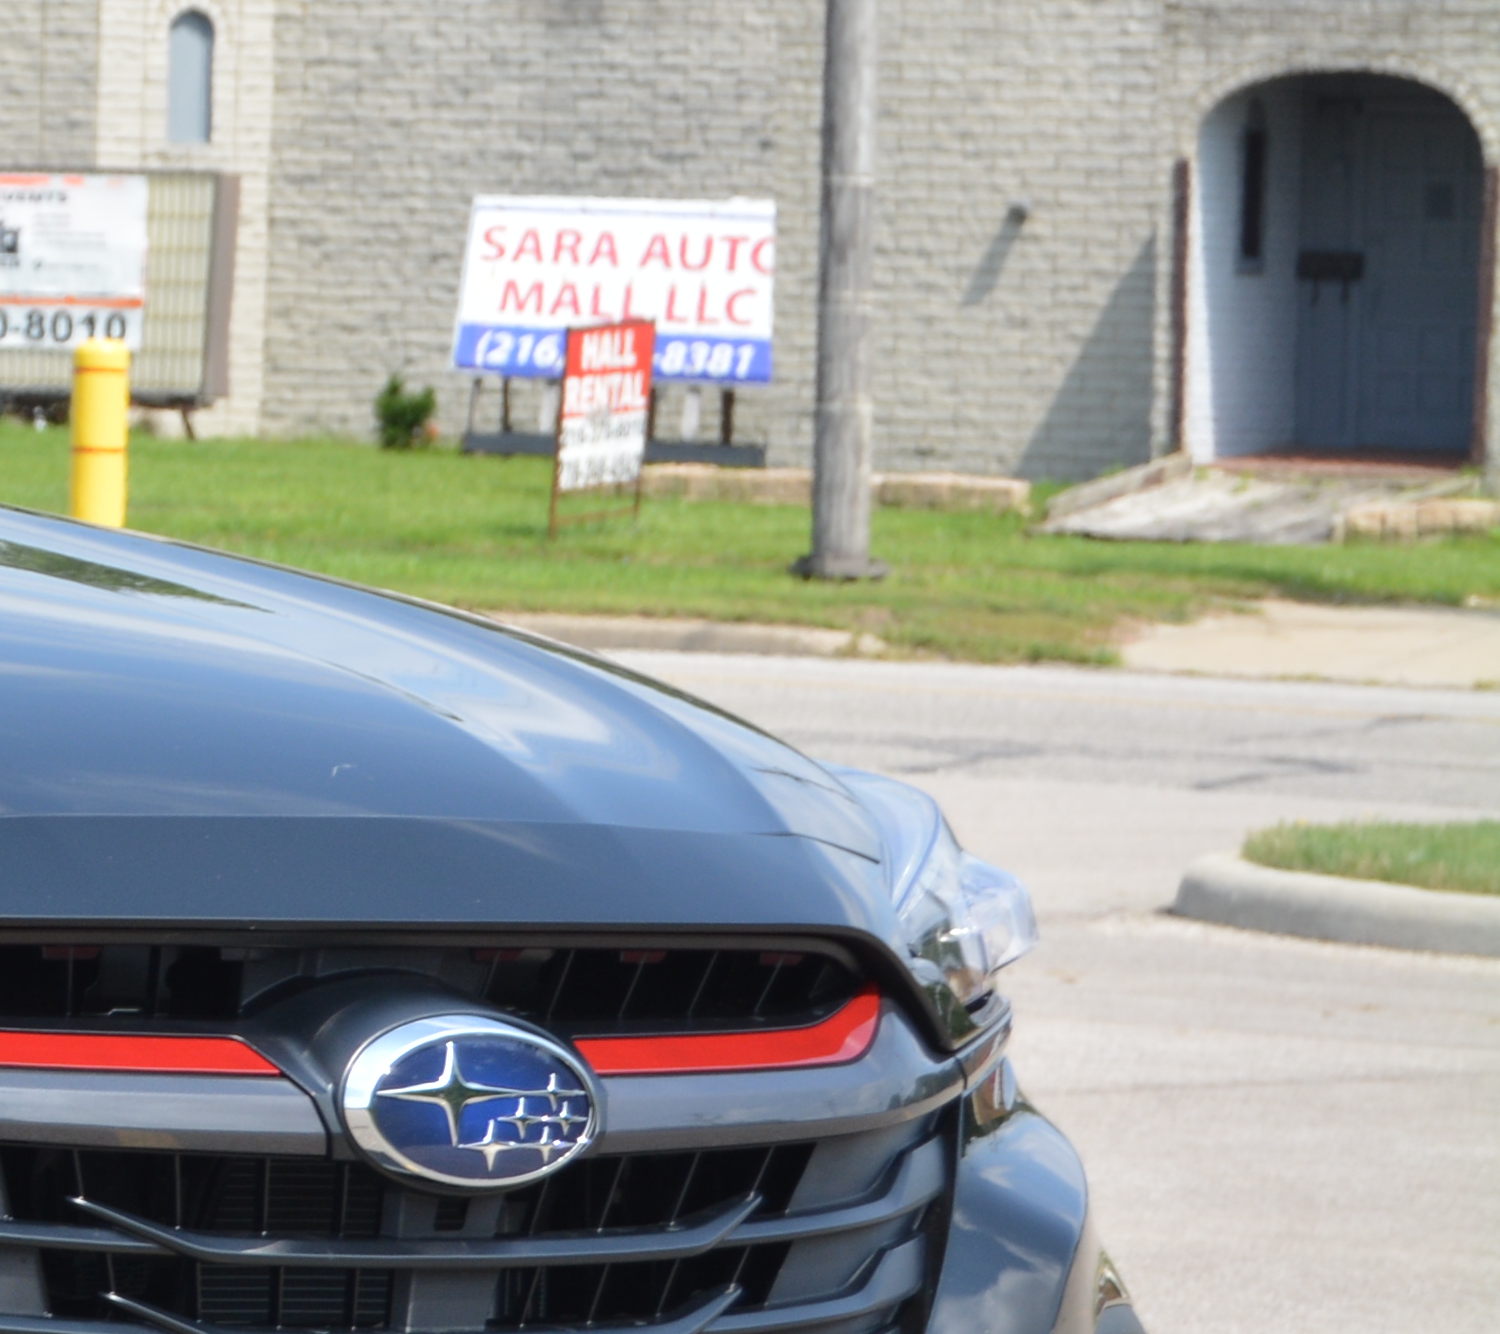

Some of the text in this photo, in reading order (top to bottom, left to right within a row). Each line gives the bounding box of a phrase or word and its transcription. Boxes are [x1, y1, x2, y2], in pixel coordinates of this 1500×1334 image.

[480, 225, 619, 268] SARA
[499, 279, 757, 325] MALL LLC
[581, 327, 637, 371] HALL
[564, 370, 648, 415] RENTAL
